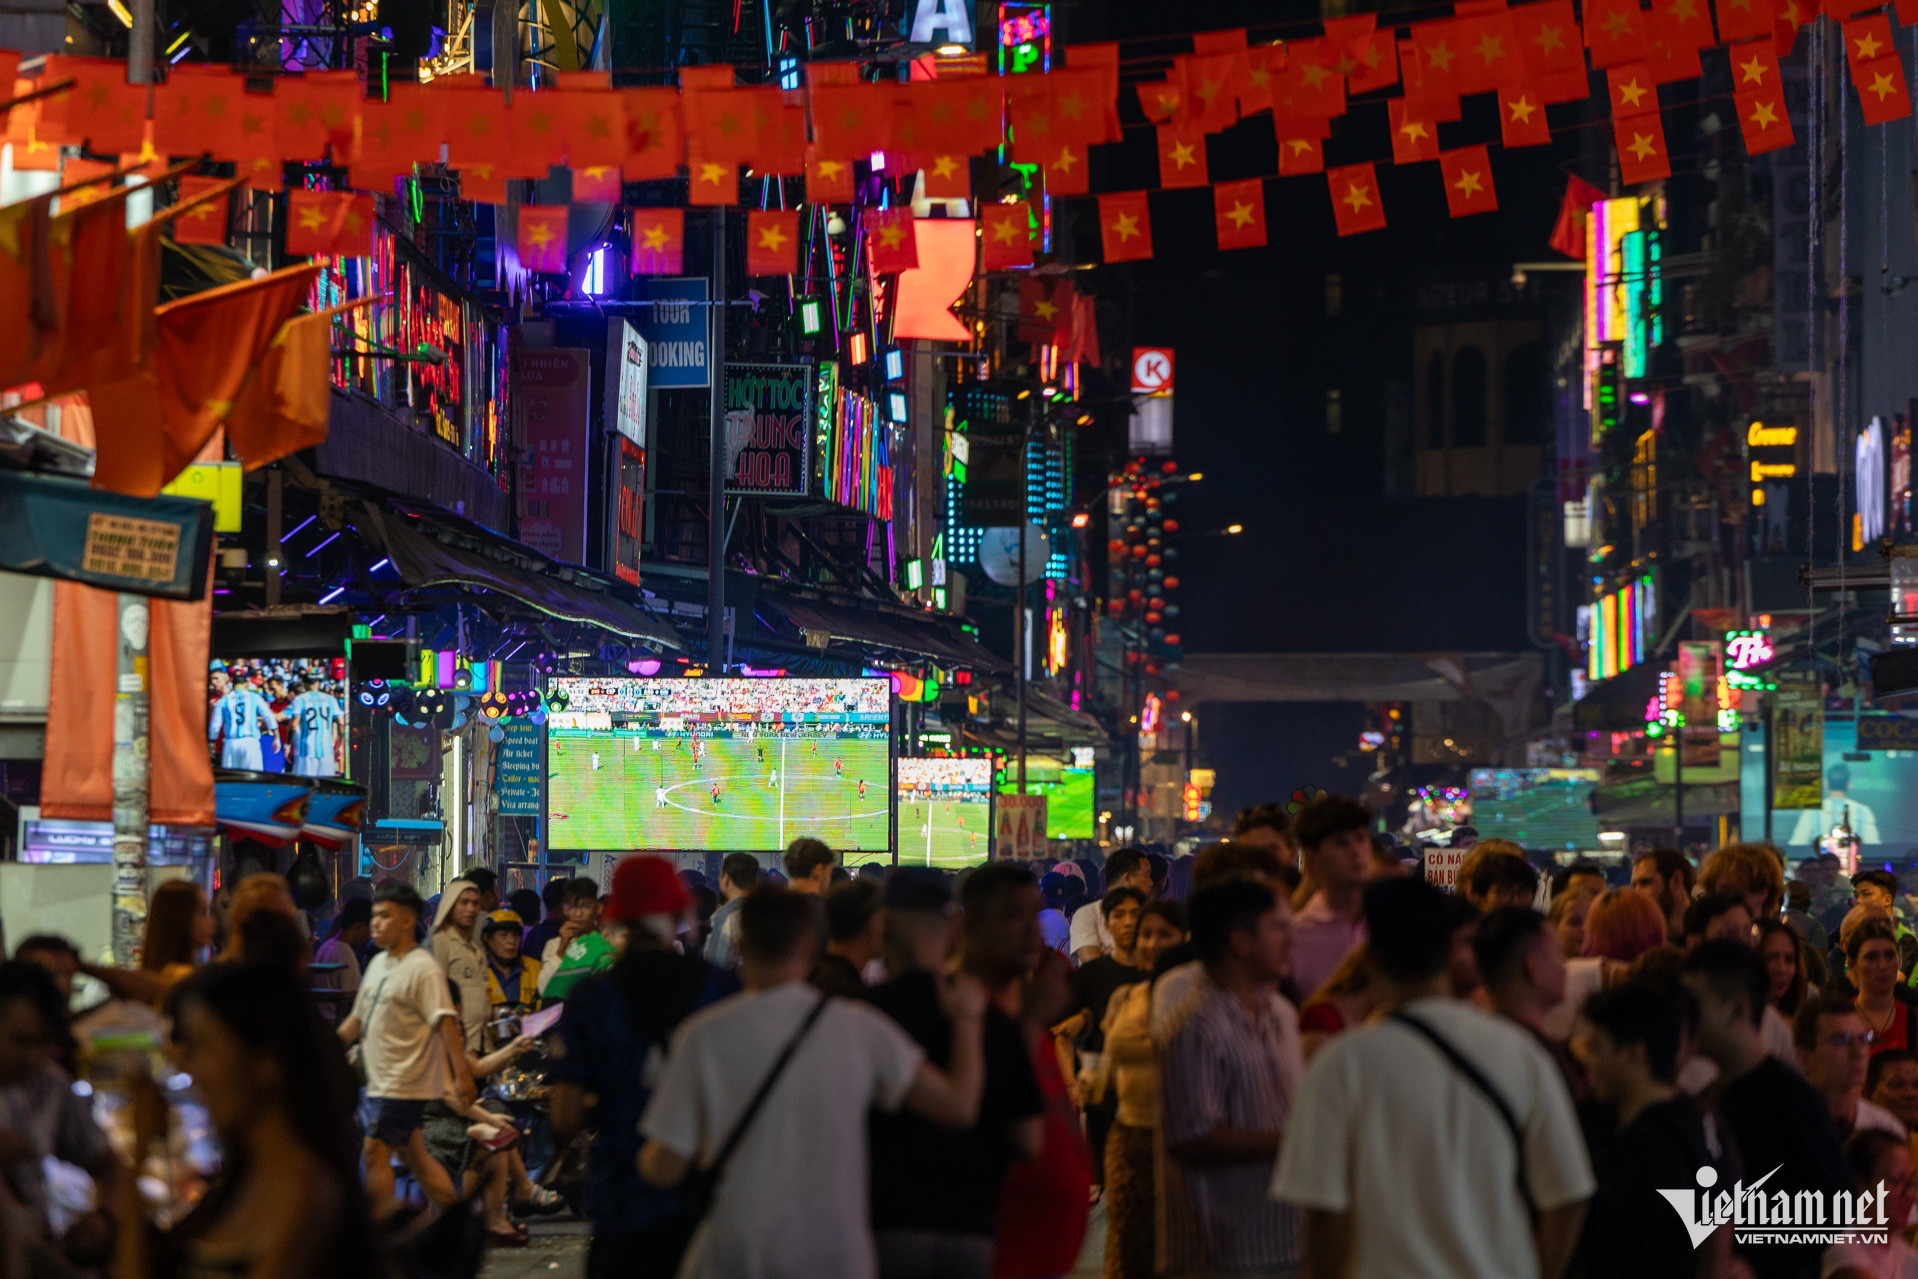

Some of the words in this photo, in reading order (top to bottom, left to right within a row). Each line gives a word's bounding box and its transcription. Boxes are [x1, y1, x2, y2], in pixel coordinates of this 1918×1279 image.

[653, 298, 690, 324] TOUR
[726, 413, 802, 449] TRUNG
[306, 706, 331, 731] 24
[519, 723, 533, 733] tour
[523, 736, 538, 746] boat
[515, 748, 533, 759] ticket
[502, 761, 531, 772] Sleeping
[500, 787, 526, 797] Private
[501, 799, 517, 809] Visa
[1428, 851, 1444, 865] CÔ
